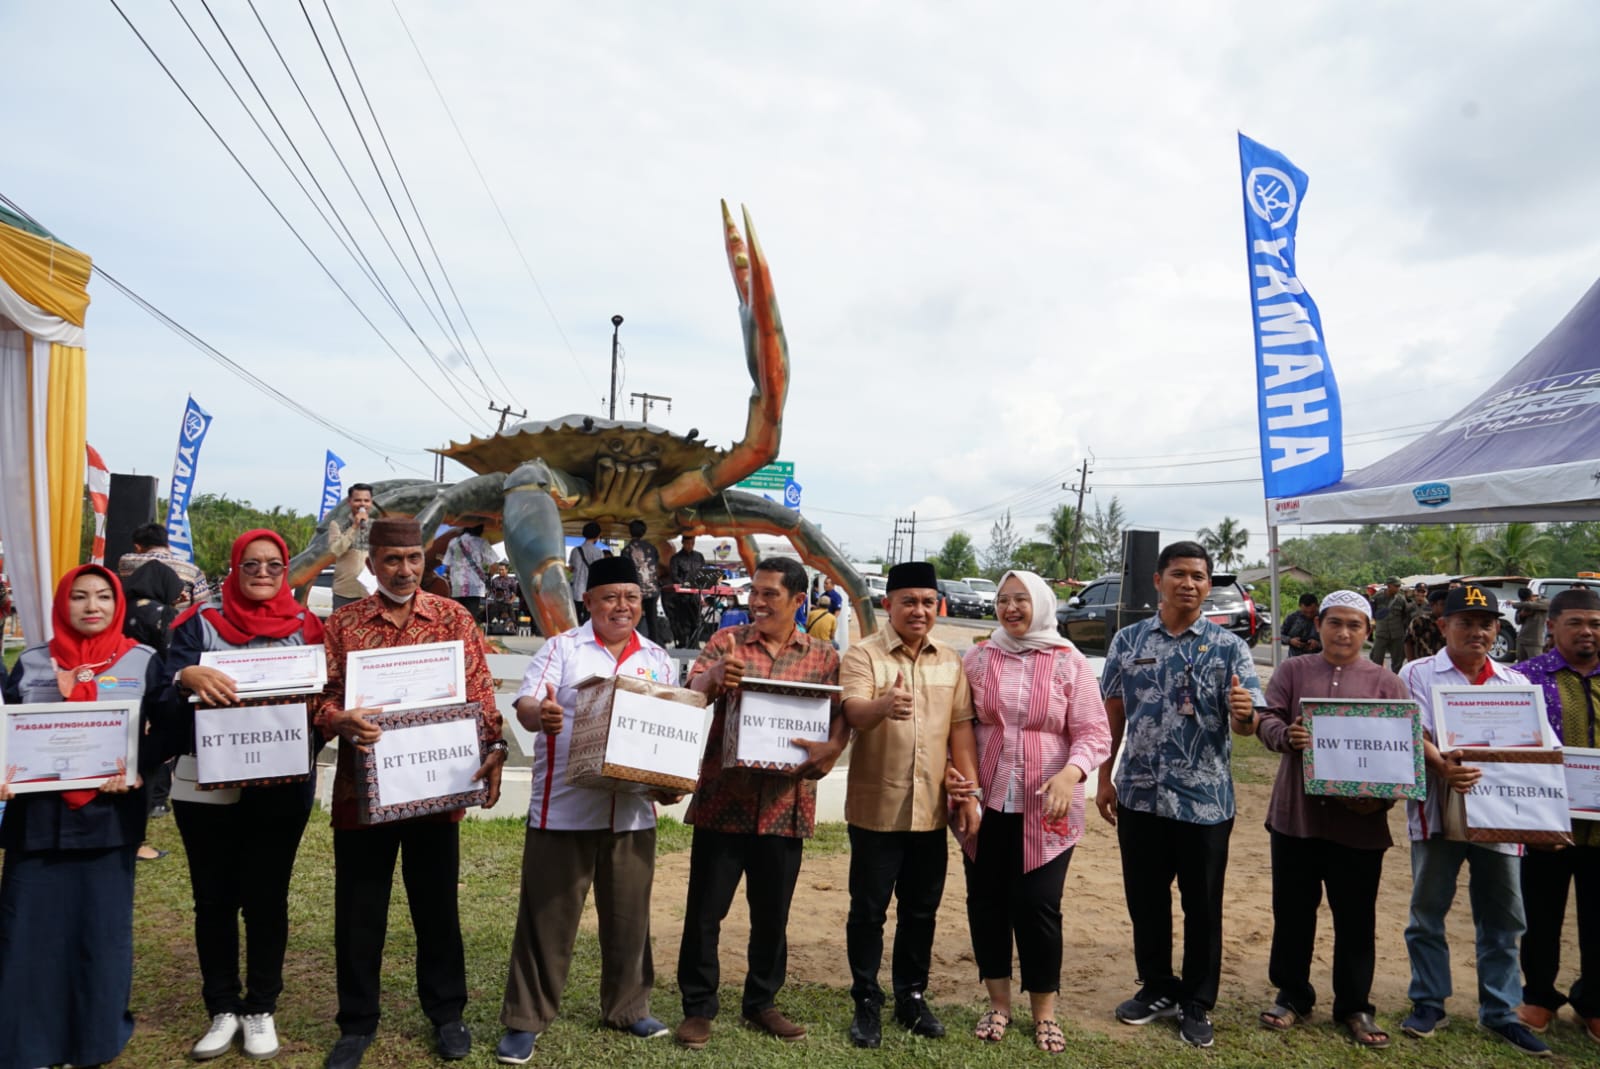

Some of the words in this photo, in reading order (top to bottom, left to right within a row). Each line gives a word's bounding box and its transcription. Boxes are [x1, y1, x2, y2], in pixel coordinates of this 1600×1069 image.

[1254, 237, 1330, 473] YAMAHA
[1464, 585, 1488, 606] LA
[362, 661, 393, 670] PIAGAM
[393, 656, 450, 667] PENGHARGAAN
[15, 722, 52, 731] PIAGAM
[54, 719, 122, 730] PENGHARGAAN
[617, 716, 637, 730] RT
[640, 720, 699, 744] TERBAIK
[743, 715, 765, 727] RW
[768, 717, 827, 733] TERBAIK
[202, 734, 225, 747] RT
[228, 728, 302, 745] TERBAIK
[777, 736, 791, 749] III
[1316, 737, 1340, 749] RW
[1344, 738, 1409, 752] TERBAIK
[653, 743, 659, 754] I
[244, 751, 261, 764] III
[383, 755, 404, 769] RT
[408, 744, 475, 765] TERBAIK
[1358, 757, 1367, 768] II
[426, 770, 437, 782] II
[1468, 784, 1492, 796] RW
[1496, 785, 1564, 799] TERBAIK
[1514, 803, 1519, 815] I
